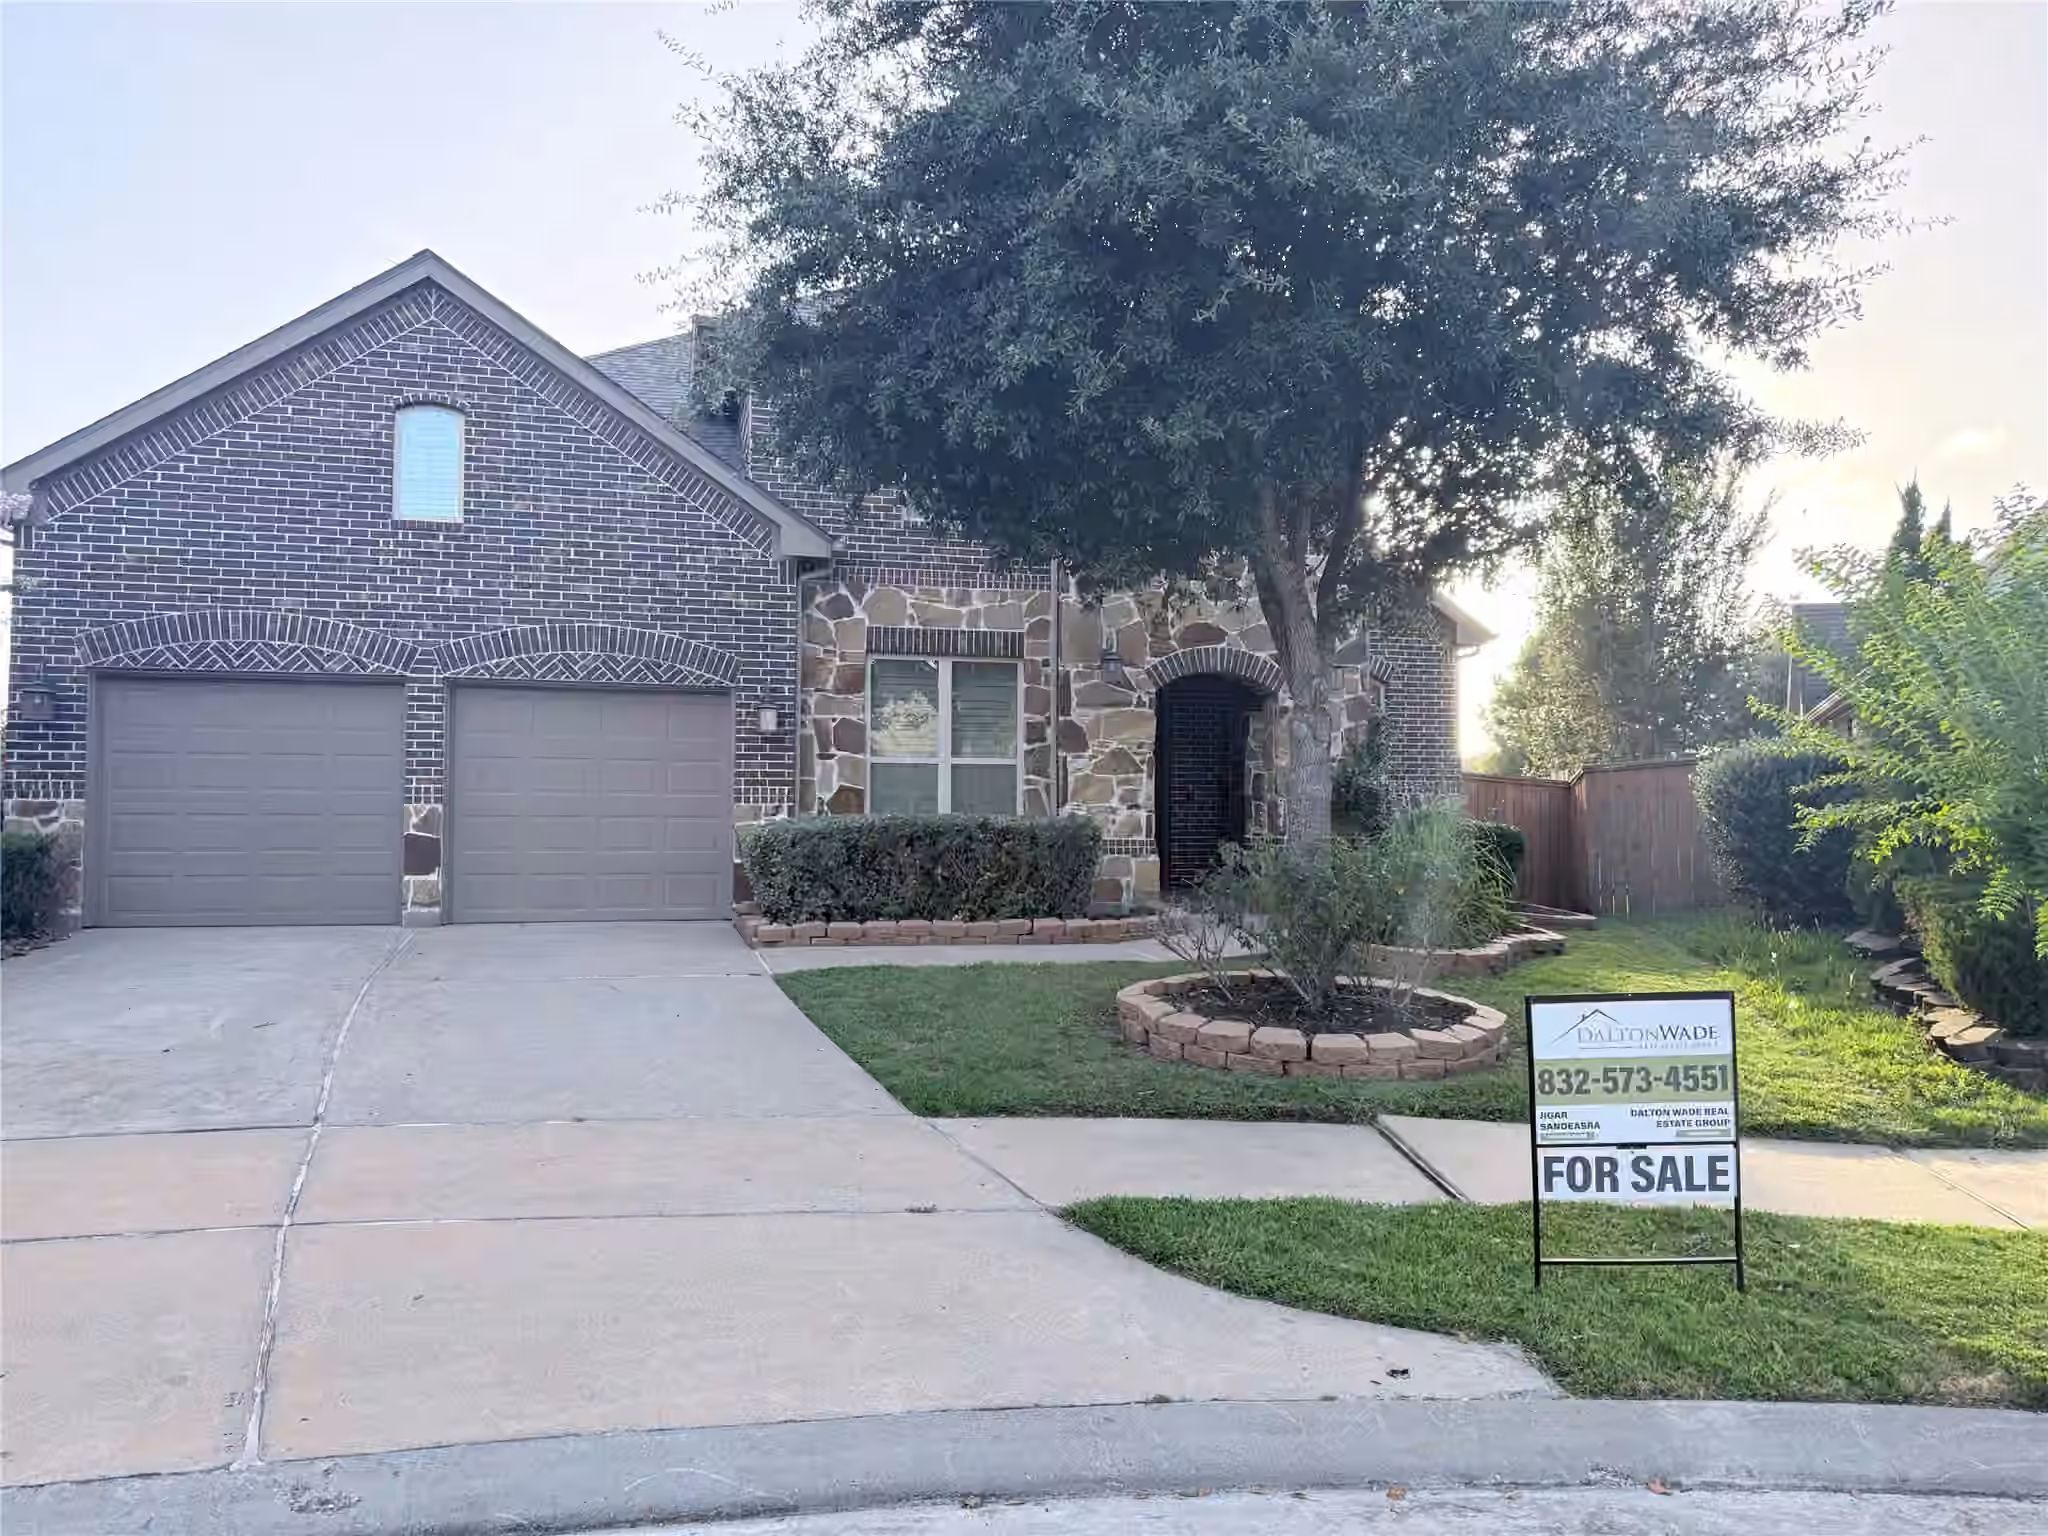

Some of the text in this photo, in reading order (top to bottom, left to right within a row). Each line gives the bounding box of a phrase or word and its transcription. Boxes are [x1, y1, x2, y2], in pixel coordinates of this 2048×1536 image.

[1537, 1064, 1729, 1096] 832-573-4551
[1540, 1111, 1568, 1120] JIGAR
[1631, 1107, 1729, 1117] DALTON WADE REAL
[1656, 1118, 1731, 1128] ESTATE GROUP
[1543, 1155, 1730, 1193] FOR SALE
